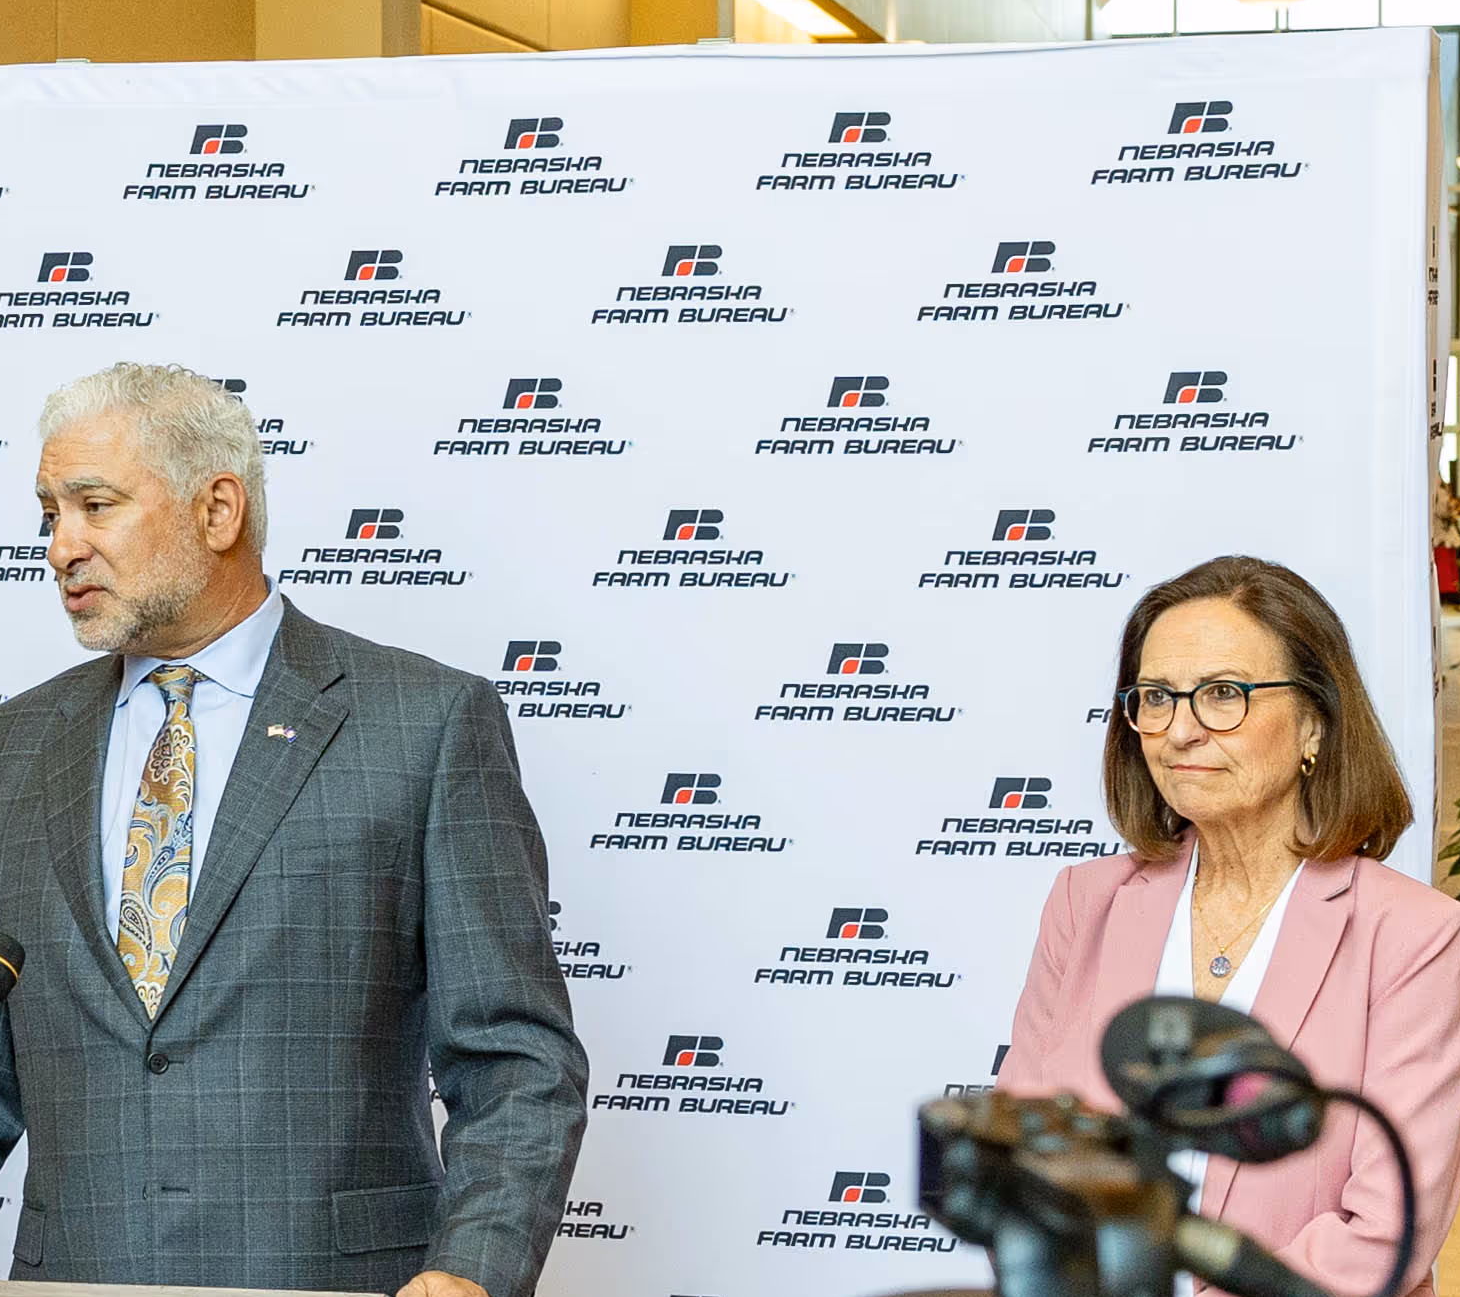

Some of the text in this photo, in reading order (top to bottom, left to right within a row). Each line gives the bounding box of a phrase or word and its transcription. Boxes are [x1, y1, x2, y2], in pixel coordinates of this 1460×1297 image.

[1118, 141, 1274, 161] NEBRASKA
[459, 157, 602, 173] NEBRASKA
[781, 153, 931, 167] NEBRASKA
[147, 163, 284, 177] NEBRASKA
[1091, 163, 1302, 184] FARM BUREAU
[435, 178, 627, 195] FARM BUREAU
[756, 174, 959, 190] FARM BUREAU
[123, 185, 309, 199] FARM BUREAU
[301, 289, 440, 304] NEBRASKA
[616, 286, 761, 301] NEBRASKA
[944, 281, 1096, 298] NEBRASKA
[277, 311, 466, 326] FARM BUREAU
[592, 308, 788, 324] FARM BUREAU
[917, 303, 1124, 321] FARM BUREAU
[53, 313, 154, 327] BUREAU
[458, 419, 601, 433] NEBRASKA
[780, 417, 929, 431] NEBRASKA
[1114, 413, 1269, 429] NEBRASKA
[259, 440, 308, 455] EAU
[434, 441, 626, 455] FARM BUREAU
[755, 439, 956, 454] FARM BUREAU
[1088, 435, 1297, 452] FARM BUREAU
[302, 549, 441, 563] NEBRASKA
[617, 550, 763, 565] NEBRASKA
[945, 551, 1096, 565] NEBRASKA
[278, 570, 467, 585] FARM BUREAU
[593, 572, 789, 587] FARM BUREAU
[919, 573, 1124, 588] FARM BUREAU
[491, 681, 601, 696] BRASKA
[780, 684, 929, 699] NEBRASKA
[518, 703, 626, 718] BUREAU
[755, 706, 956, 721] FARM BUREAU
[615, 813, 760, 829] NEBRASKA
[941, 818, 1093, 834] NEBRASKA
[590, 835, 787, 852] FARM BUREAU
[916, 840, 1119, 857] FARM BUREAU
[780, 947, 928, 964] NEBRASKA
[560, 963, 625, 979] REAU
[755, 969, 956, 987] FARM BUREAU
[617, 1074, 763, 1092] NEBRASKA
[591, 1095, 789, 1115] FARM BUREAU
[781, 1209, 930, 1230] NEBRASKA
[557, 1222, 629, 1240] REAU
[757, 1231, 957, 1253] FARM BUREAU
